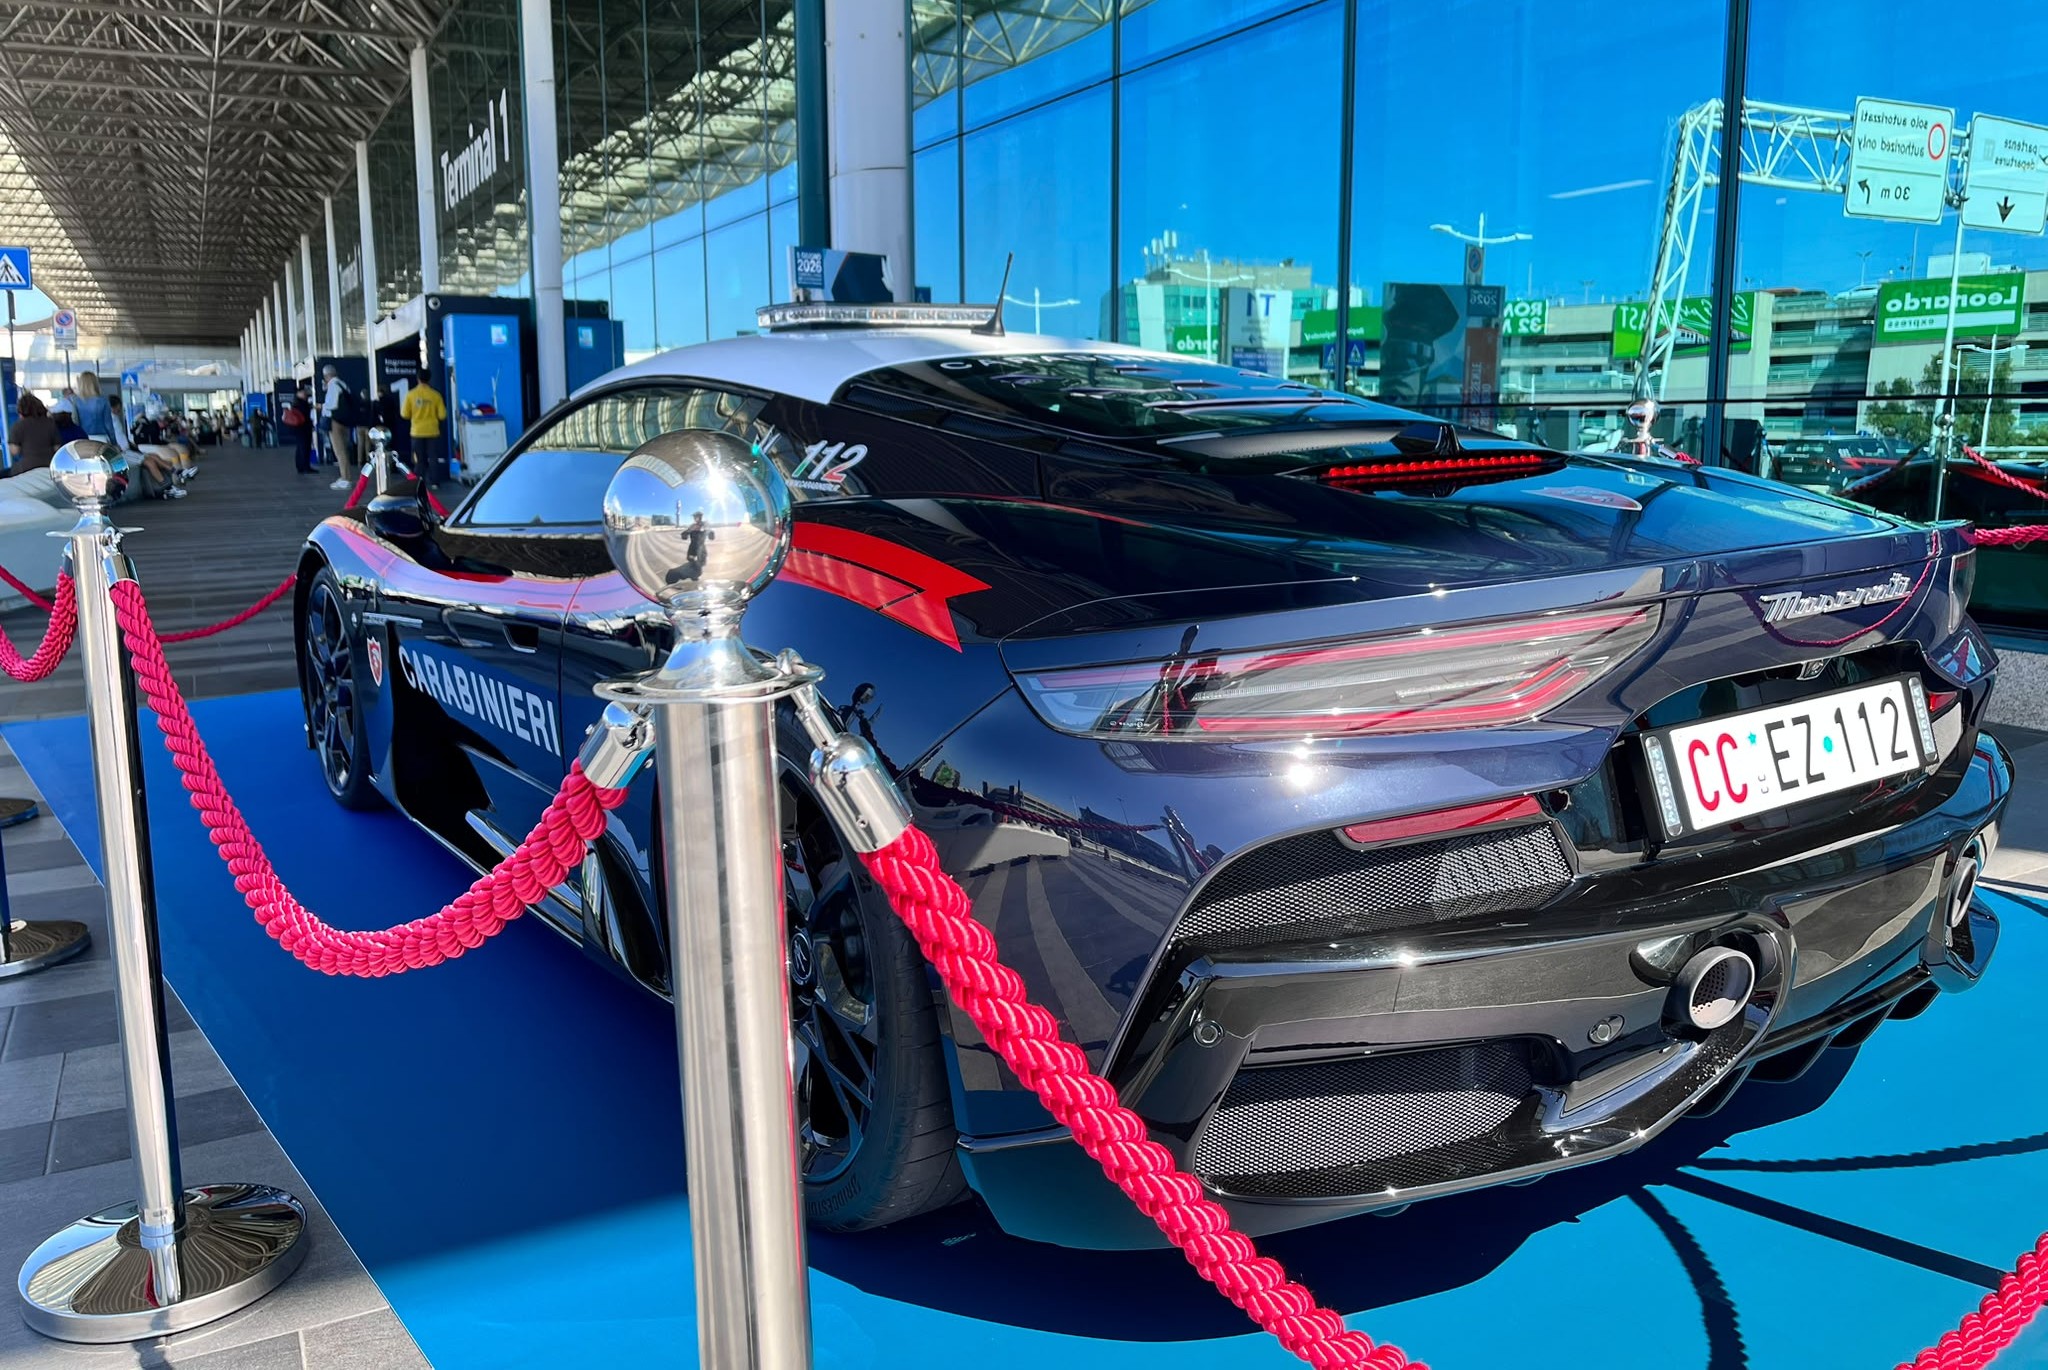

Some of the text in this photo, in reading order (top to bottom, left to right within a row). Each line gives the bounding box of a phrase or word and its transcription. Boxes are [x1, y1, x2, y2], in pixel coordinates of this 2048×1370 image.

[441, 87, 509, 212] Terminal 1
[797, 259, 822, 273] 2026
[791, 440, 868, 483] 112
[1759, 572, 1913, 622] Maserati
[398, 645, 561, 757] CARABINIERI
[1688, 696, 1908, 811] CC EZ 112
